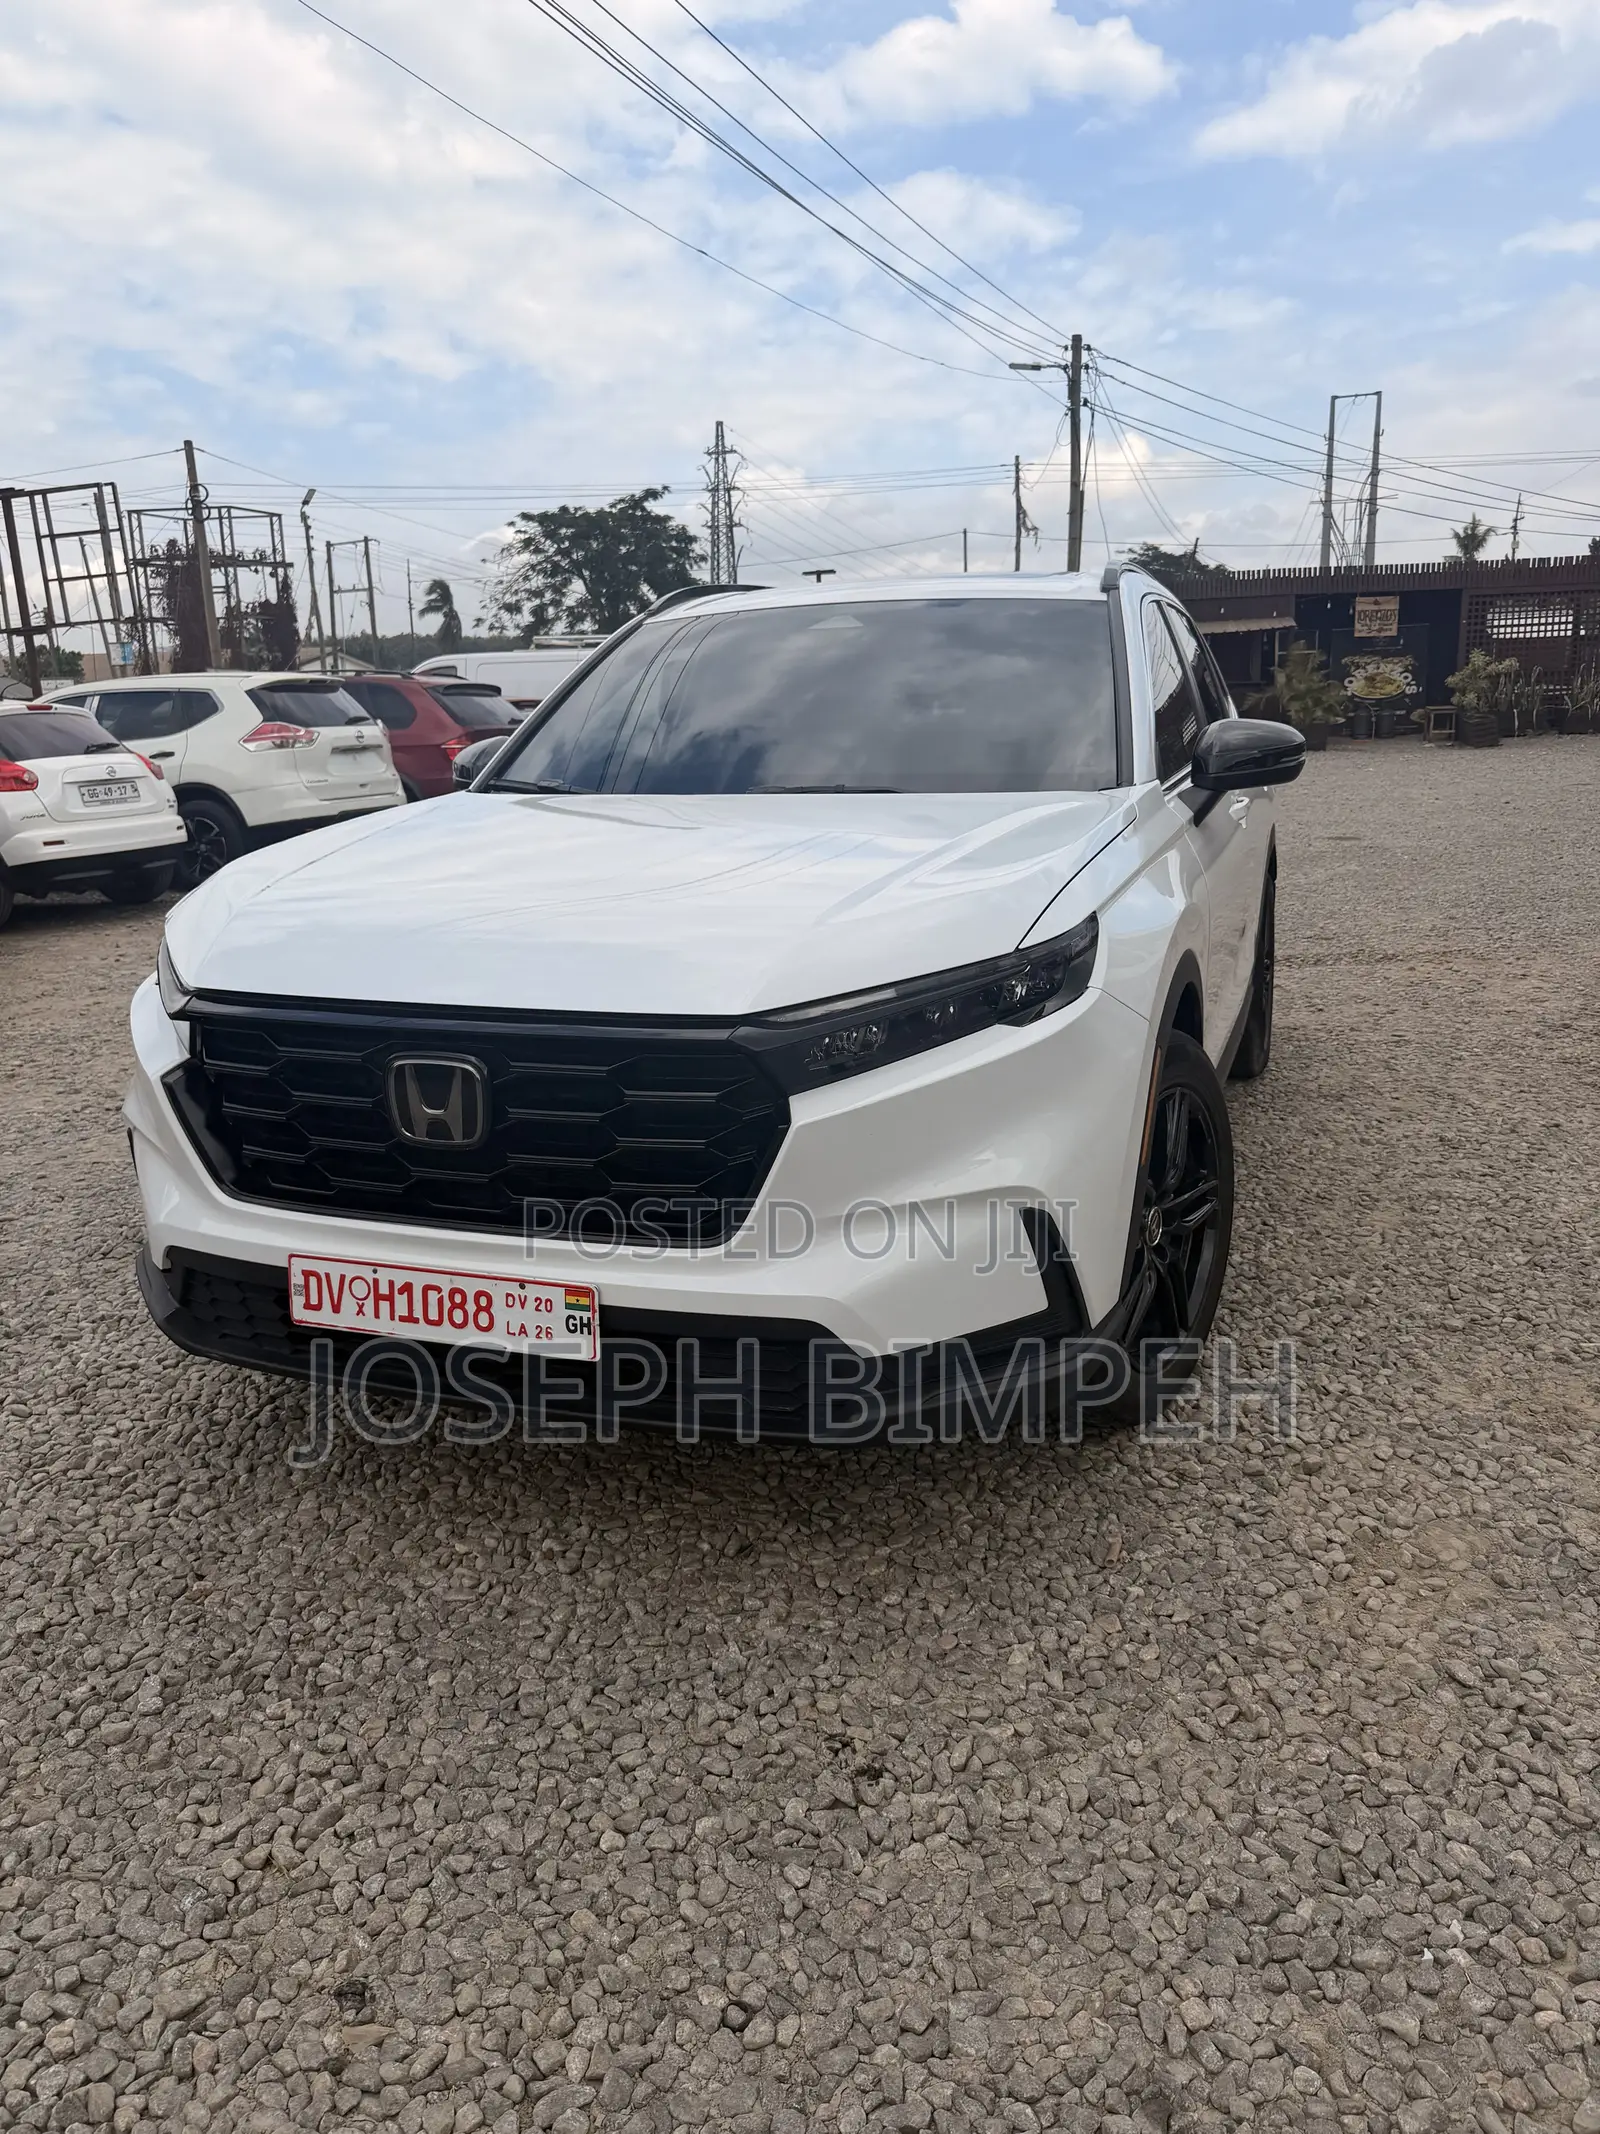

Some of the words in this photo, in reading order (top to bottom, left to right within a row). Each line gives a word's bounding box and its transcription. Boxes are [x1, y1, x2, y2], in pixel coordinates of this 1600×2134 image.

[505, 1292, 528, 1311] DV
[534, 1296, 553, 1313] 20
[506, 1320, 529, 1338] LA
[535, 1324, 553, 1340] 26
[565, 1314, 592, 1335] GH
